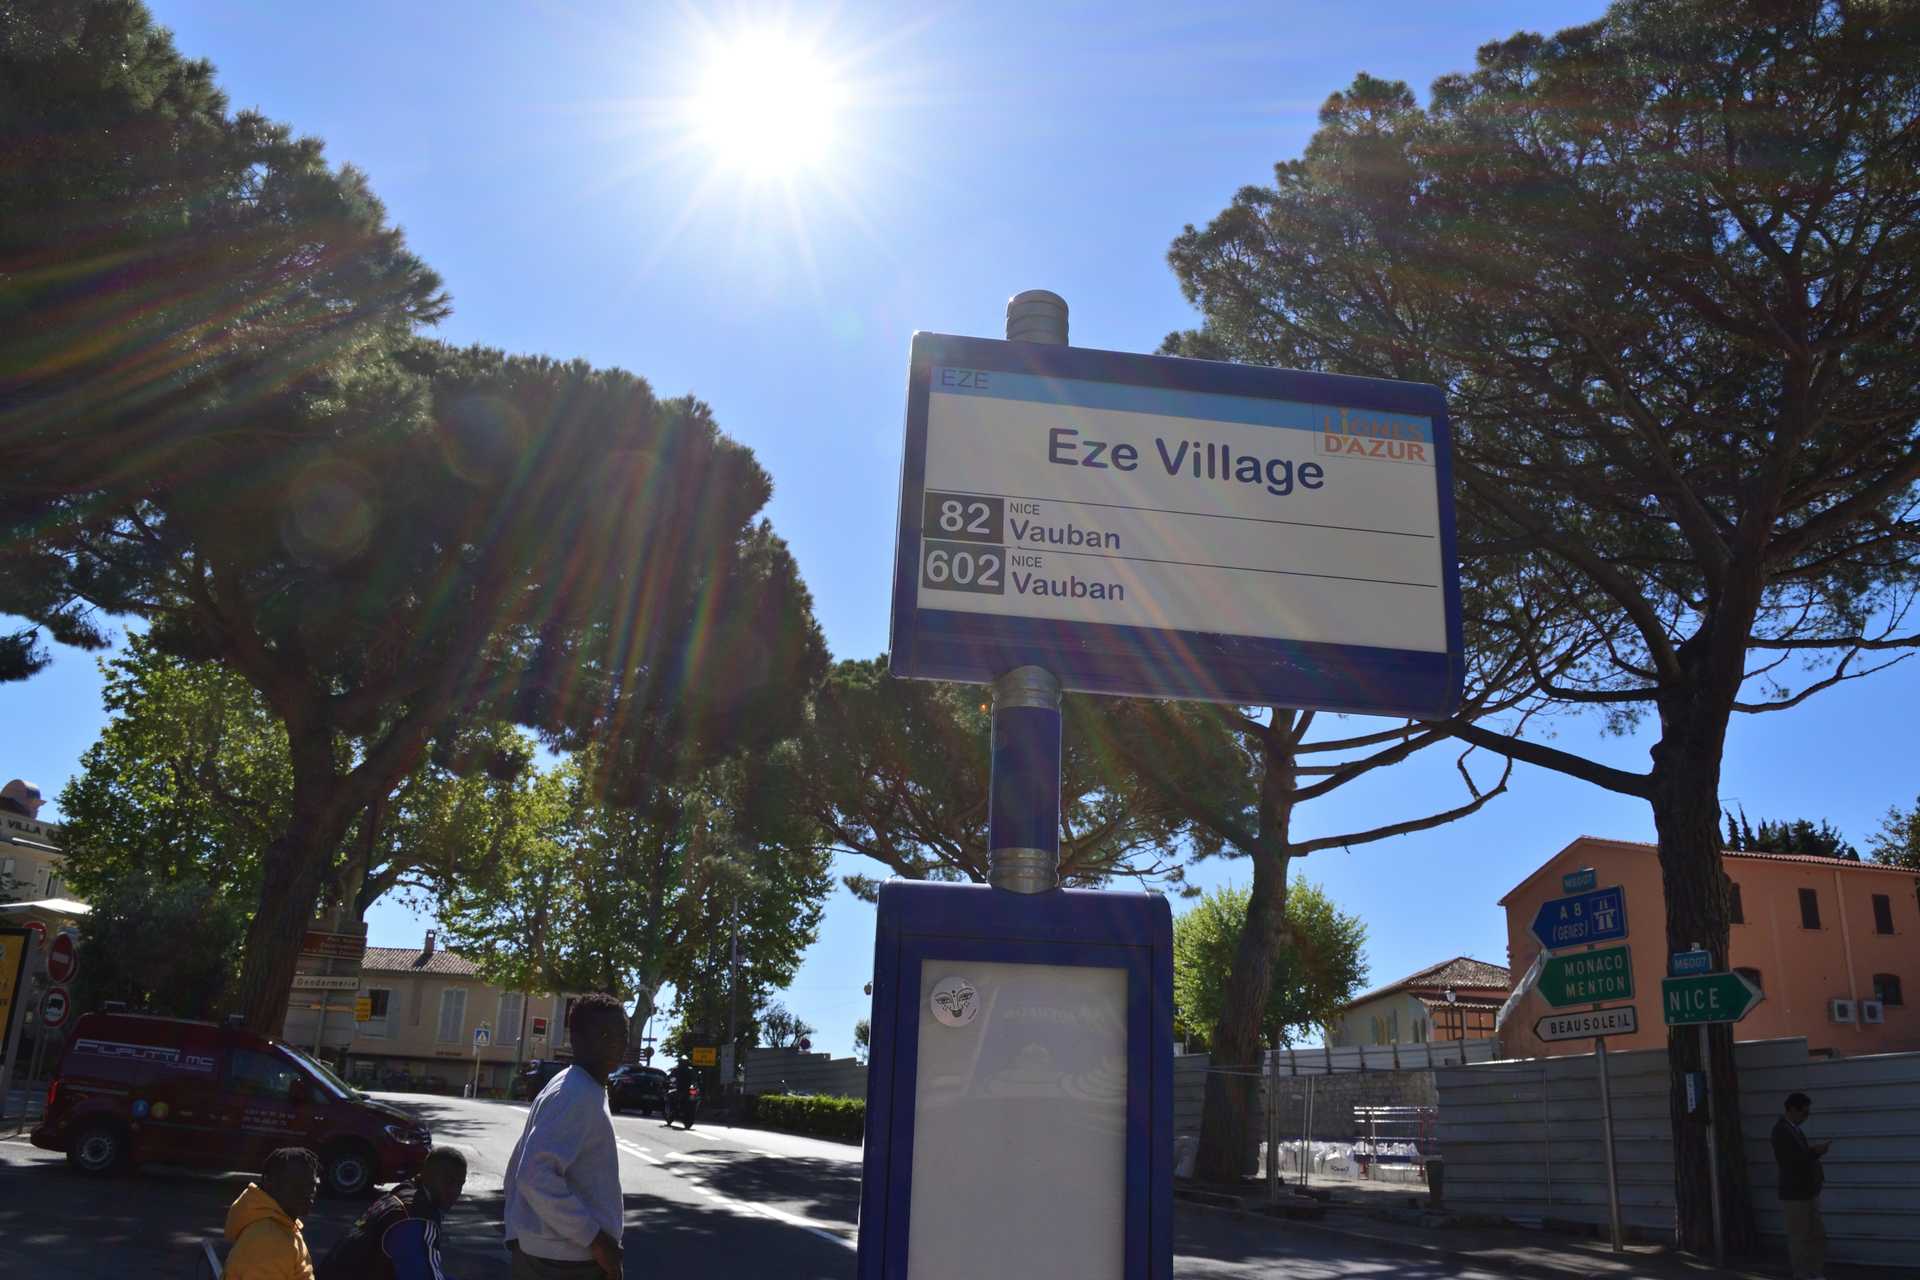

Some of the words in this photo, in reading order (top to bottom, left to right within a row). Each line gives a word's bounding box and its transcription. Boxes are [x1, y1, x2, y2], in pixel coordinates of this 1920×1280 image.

[941, 368, 990, 391] EZE
[1323, 433, 1427, 462] D'AZUR
[1048, 427, 1139, 472] Eze
[1155, 437, 1325, 497] Village
[938, 500, 991, 536] 82
[1009, 502, 1041, 517] NICE
[1010, 518, 1121, 550] Vauban
[926, 549, 1000, 588] 602
[1011, 554, 1043, 569] NICE
[1012, 571, 1125, 602] Vauban
[1559, 905, 1569, 919] A
[1564, 954, 1624, 977] MONACO
[1566, 976, 1625, 998] MENTON
[1669, 988, 1720, 1011] NICE
[1550, 1014, 1631, 1034] BEAUSOLEIL
